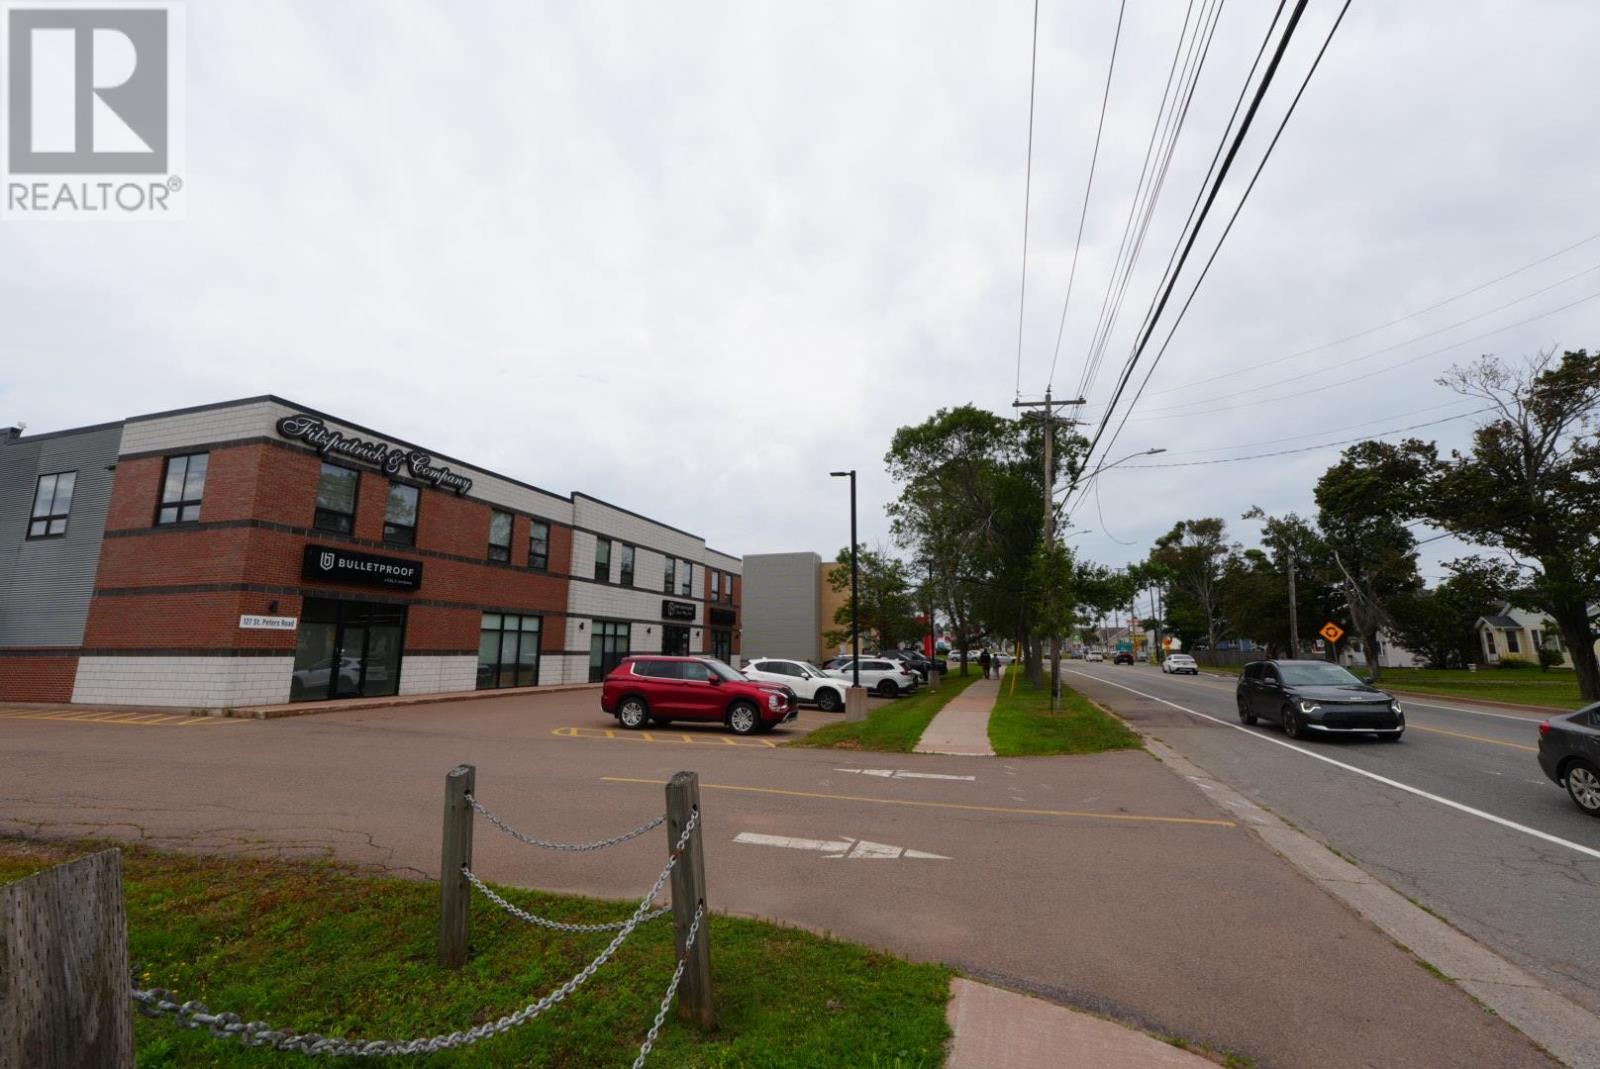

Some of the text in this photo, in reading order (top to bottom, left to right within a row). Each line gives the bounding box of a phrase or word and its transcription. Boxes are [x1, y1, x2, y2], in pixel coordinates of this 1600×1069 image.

[282, 416, 472, 491] Fitzpatrick & Company
[338, 558, 415, 577] BULLETPROOF
